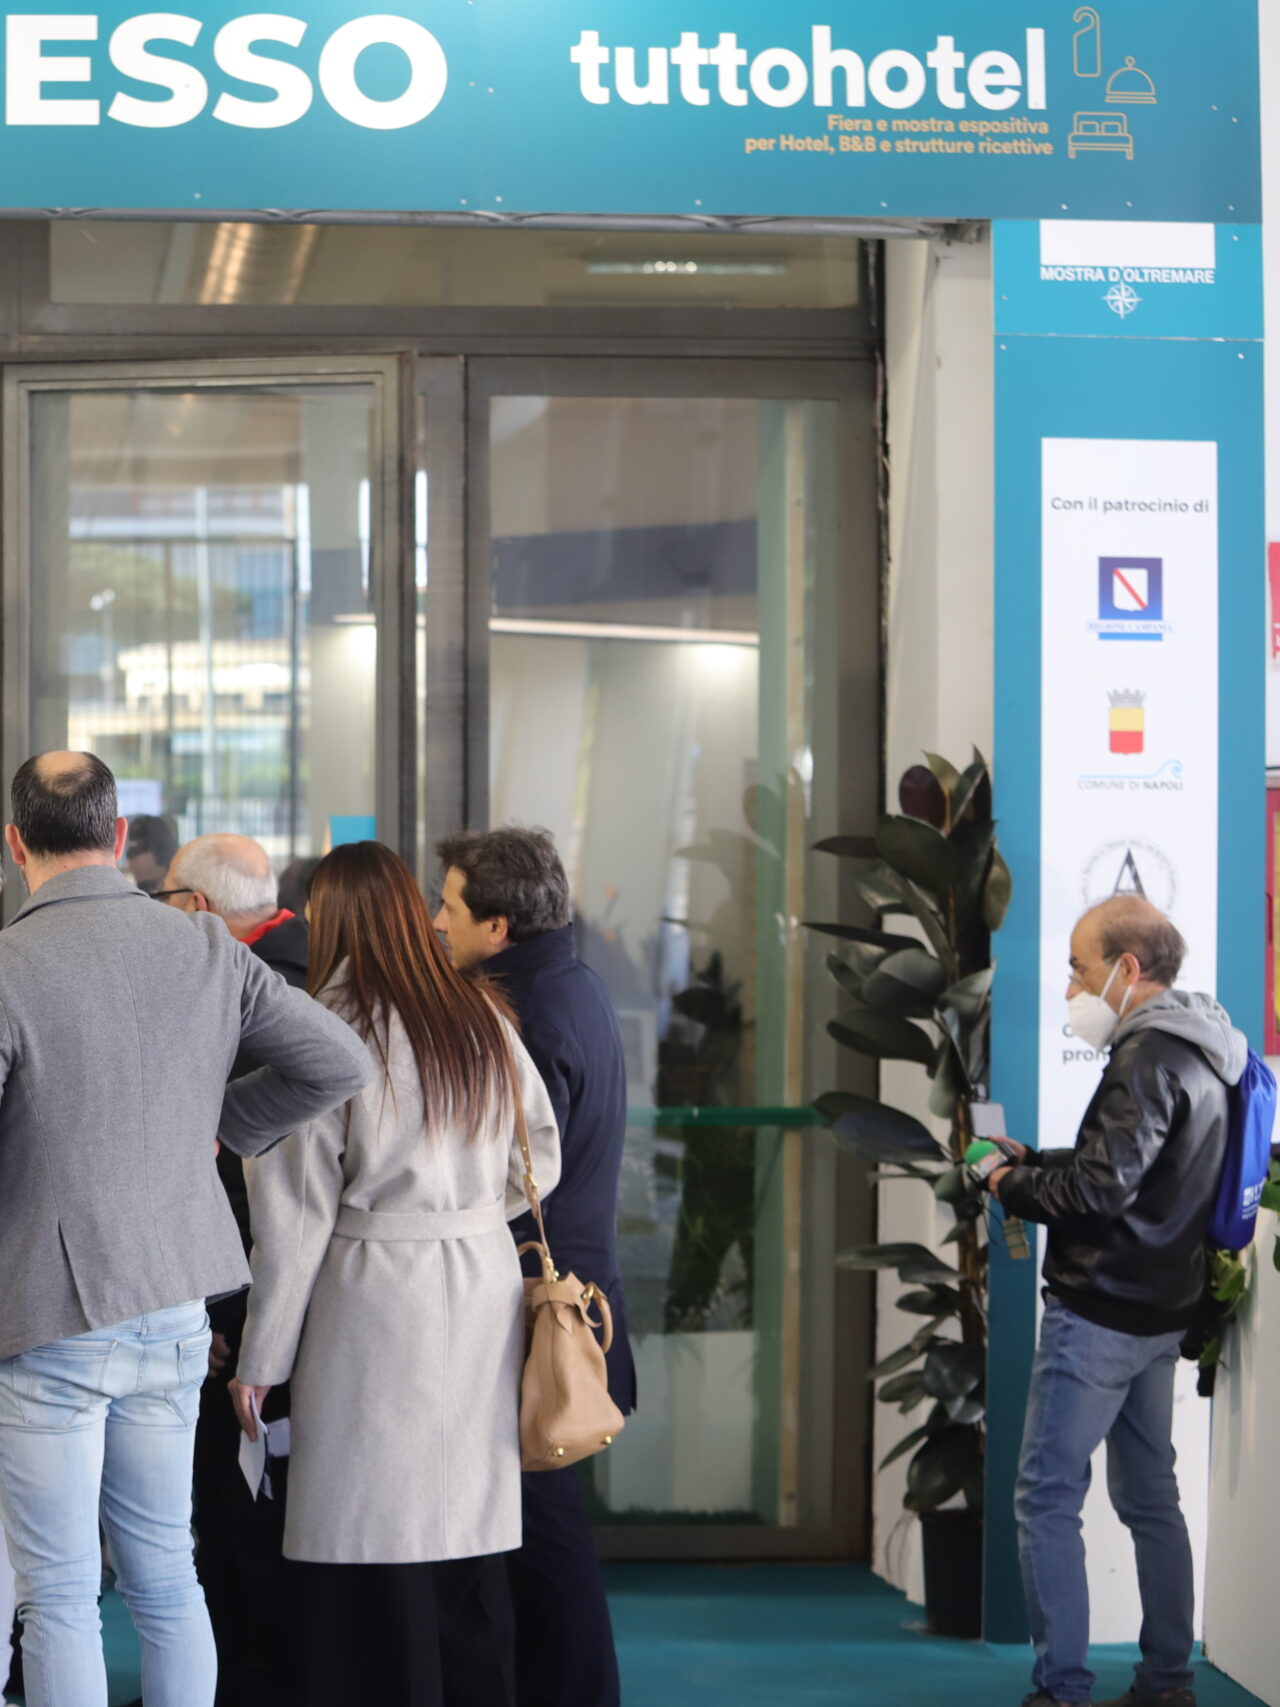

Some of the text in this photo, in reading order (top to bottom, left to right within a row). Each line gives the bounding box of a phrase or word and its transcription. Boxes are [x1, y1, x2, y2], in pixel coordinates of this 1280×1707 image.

[570, 25, 1046, 111] tuttohotel
[827, 114, 1048, 135] Fiera e mostra espositiva
[745, 134, 1053, 155] per Hotel, B&B e strutture ricettive
[1040, 266, 1106, 282] MOSTRA
[1050, 497, 1209, 514] Con il patrocinio di
